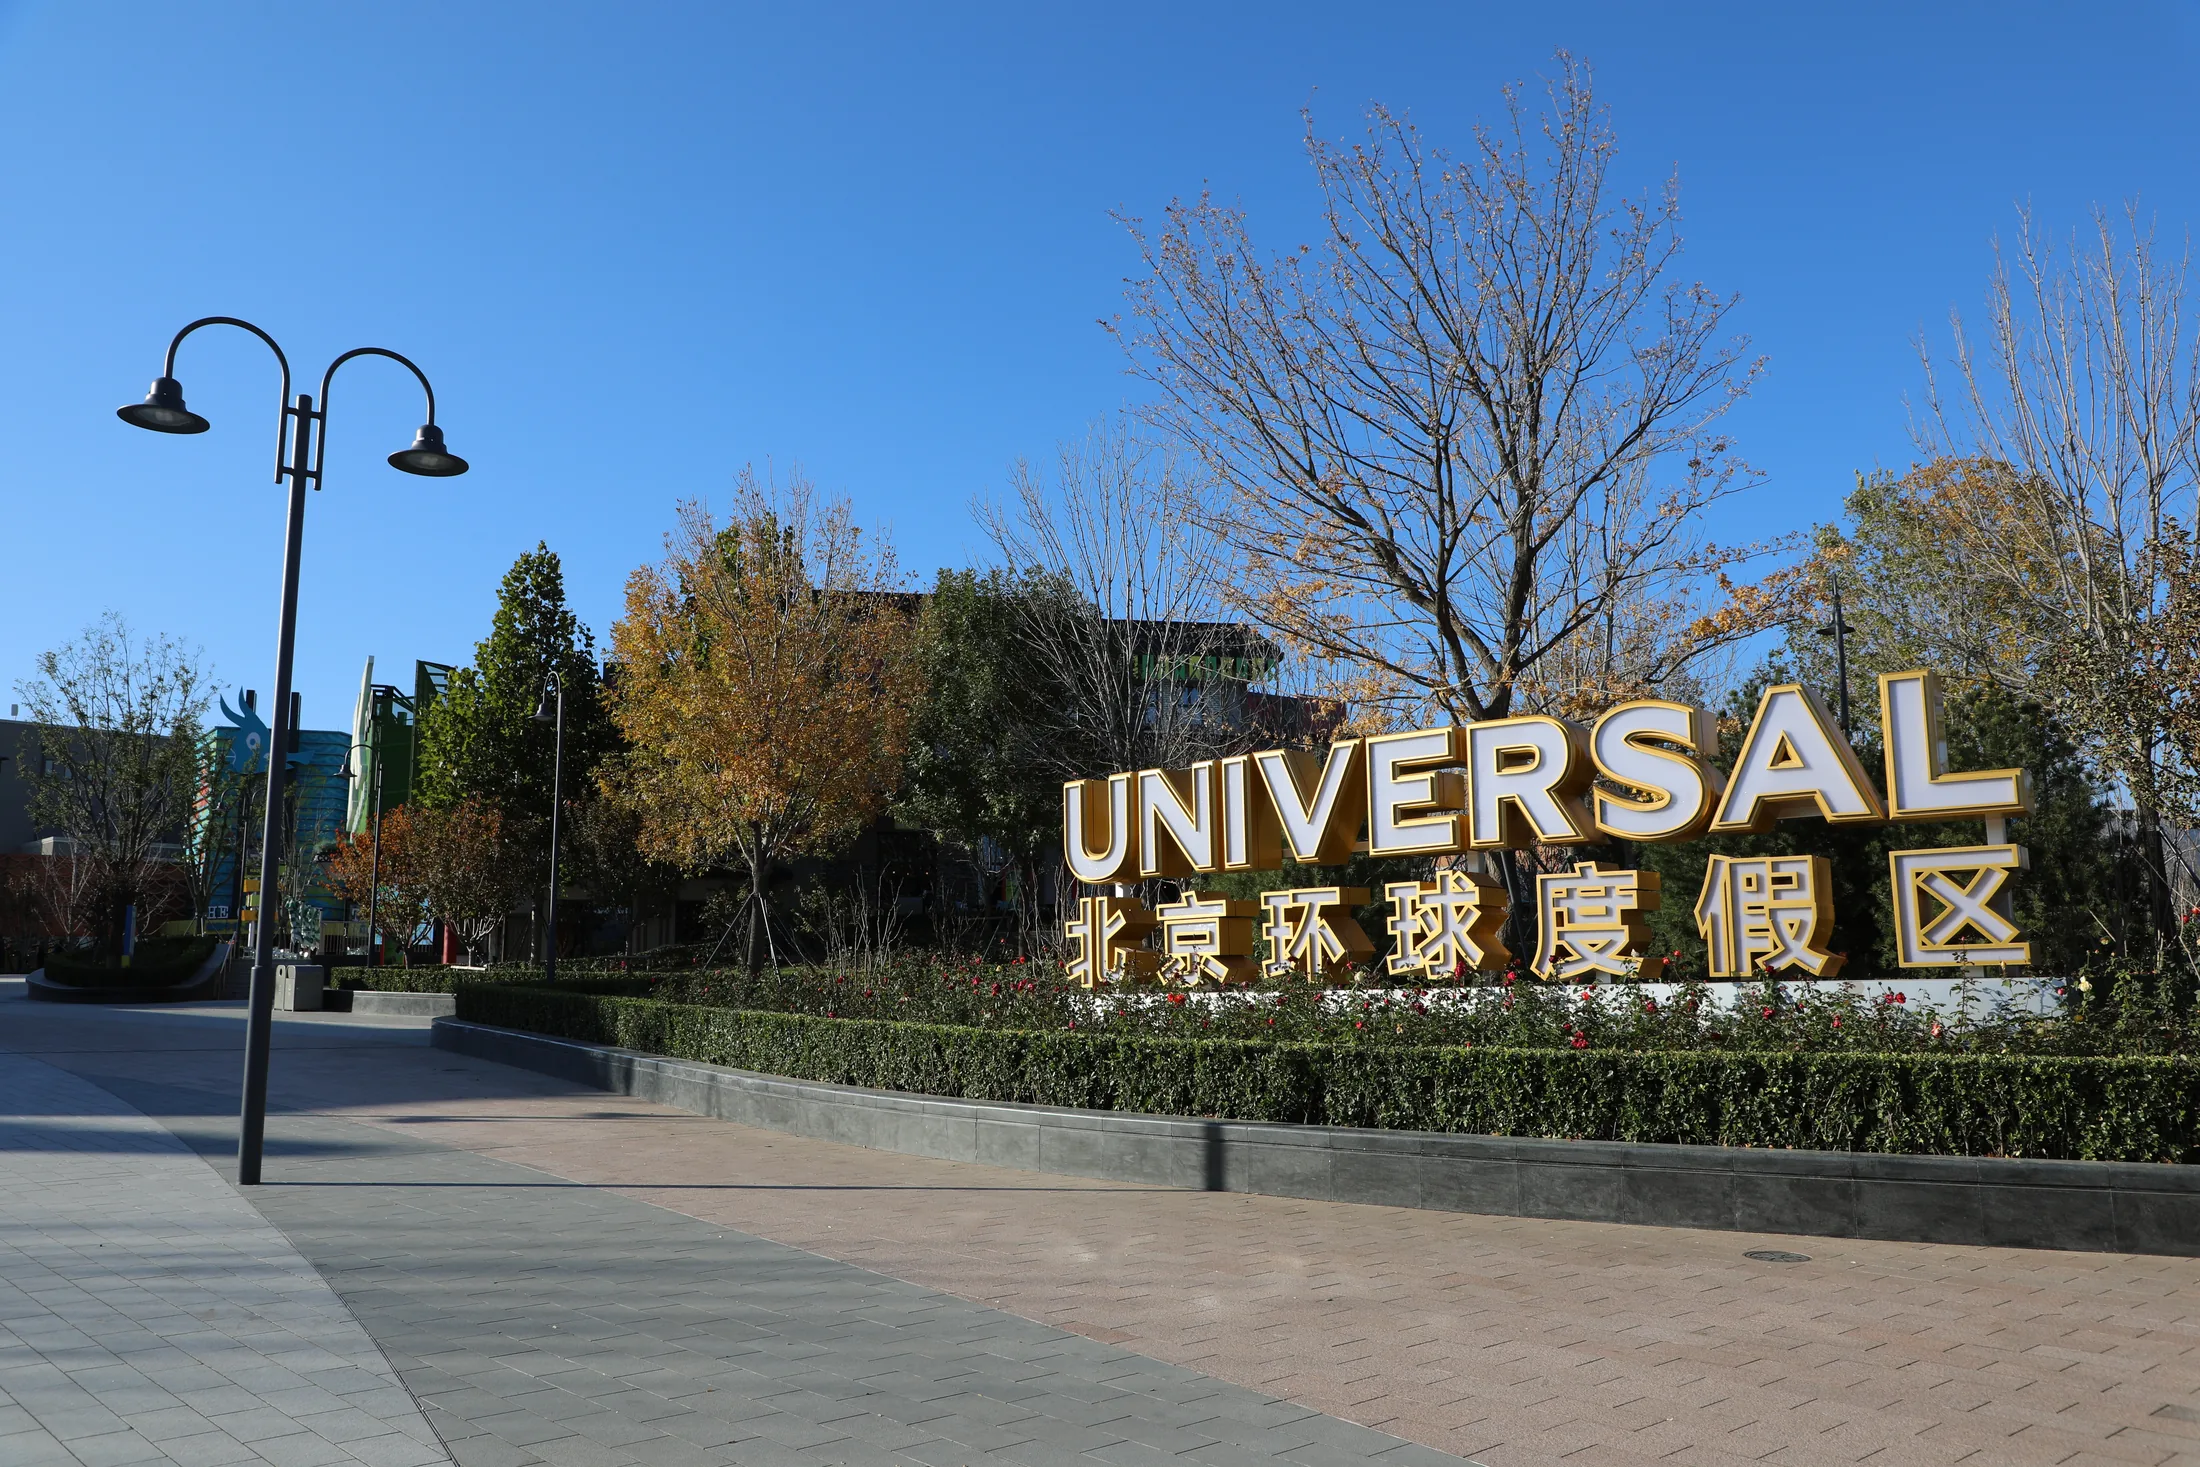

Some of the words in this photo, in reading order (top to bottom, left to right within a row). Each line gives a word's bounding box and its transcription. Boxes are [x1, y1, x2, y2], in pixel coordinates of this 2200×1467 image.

[1064, 669, 2032, 884] UNIVERSAL
[1065, 843, 2031, 988] 北京环球度假区
